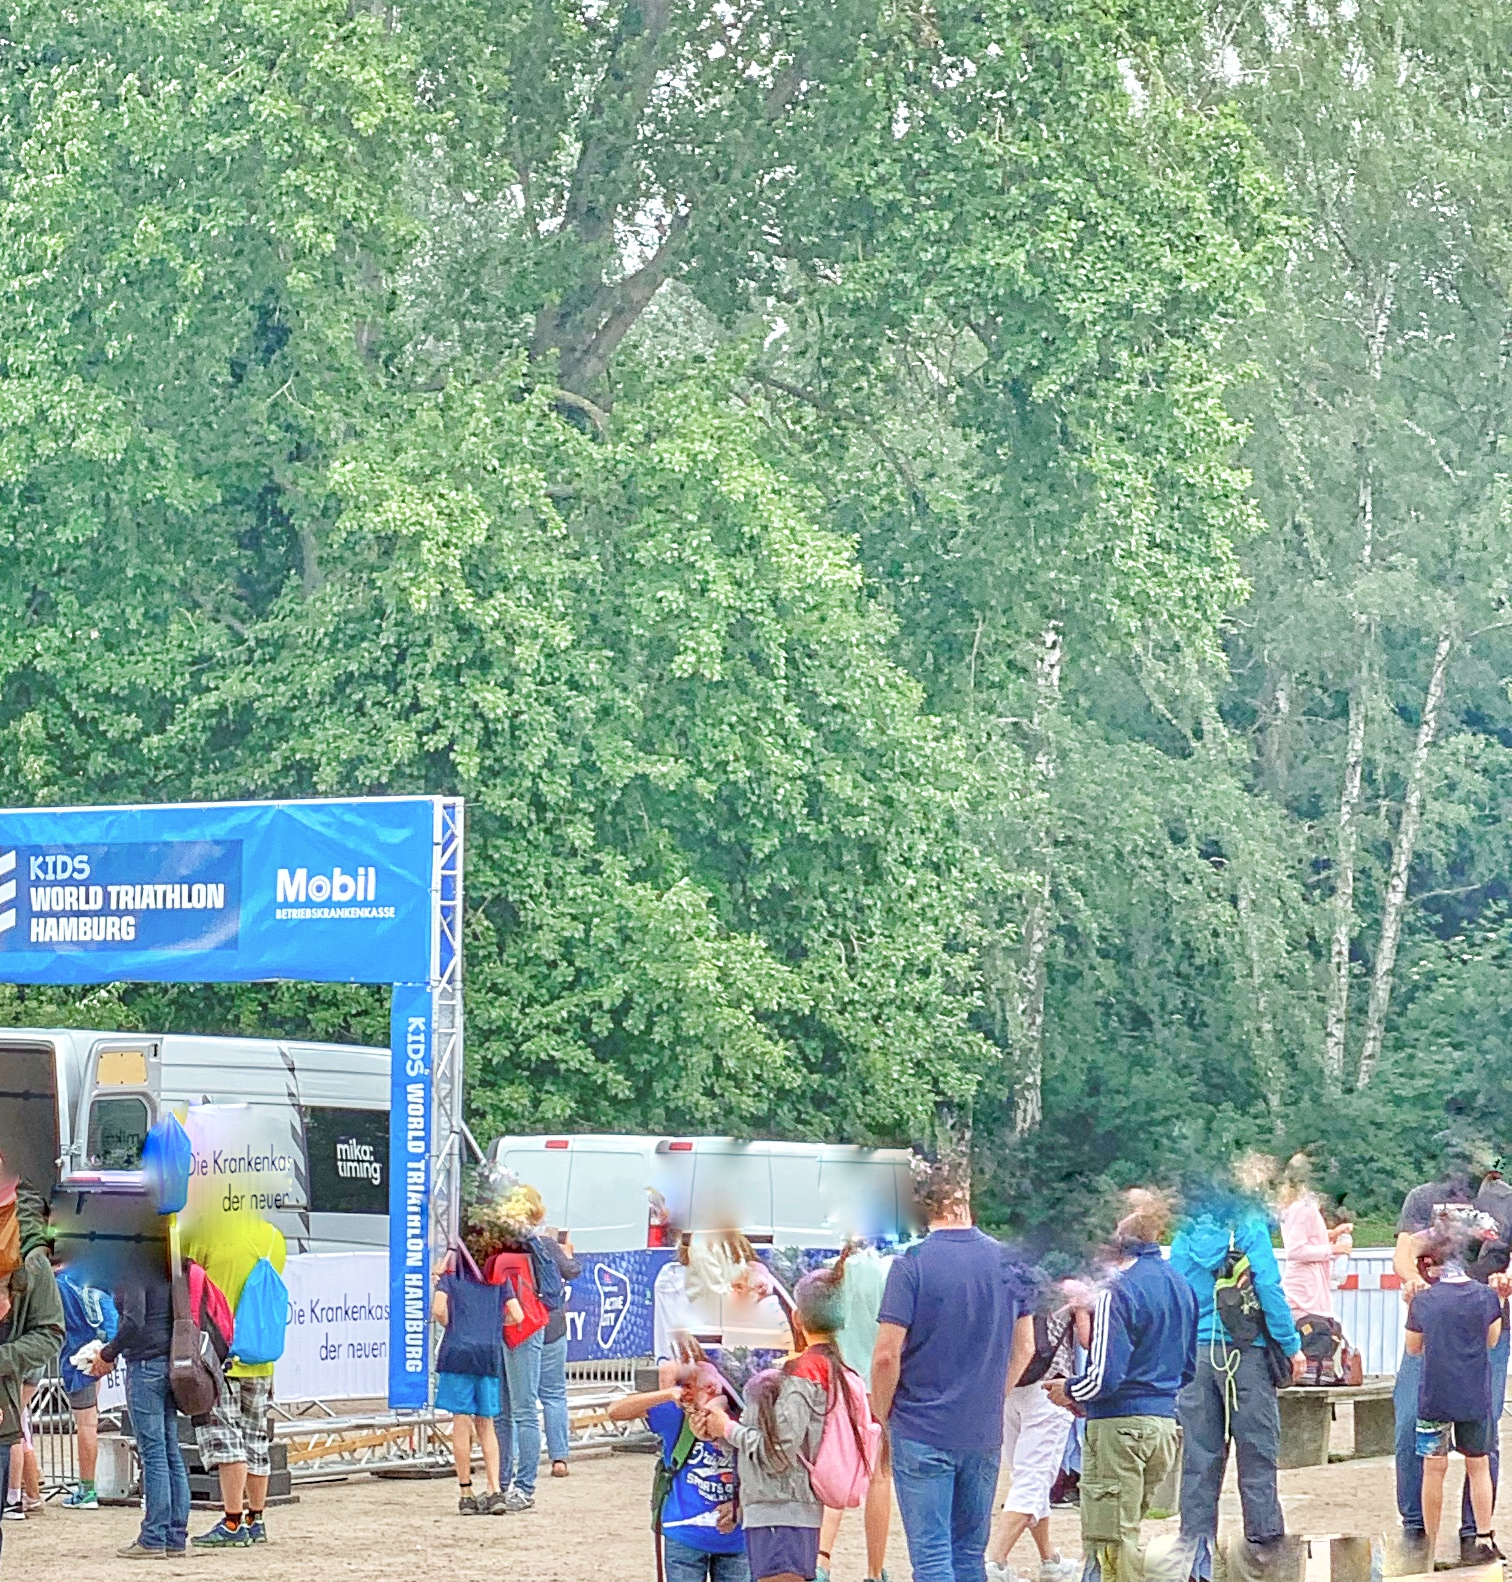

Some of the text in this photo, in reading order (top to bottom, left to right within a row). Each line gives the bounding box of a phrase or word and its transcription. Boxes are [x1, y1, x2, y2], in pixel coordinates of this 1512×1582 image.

[29, 854, 91, 881] KIDS
[29, 883, 224, 911] WORLD TRIATHLON
[276, 866, 376, 902] Mobil
[275, 906, 396, 919] BETRIEBSKRANKENKASSE
[30, 916, 136, 942] HAMBURG
[336, 1138, 375, 1161] mika:
[337, 1161, 381, 1186] timing
[222, 1183, 245, 1212] der
[404, 1016, 426, 1373] KIDS WORLD TRIATHLON HAMBURG
[320, 1332, 386, 1361] der neuen
